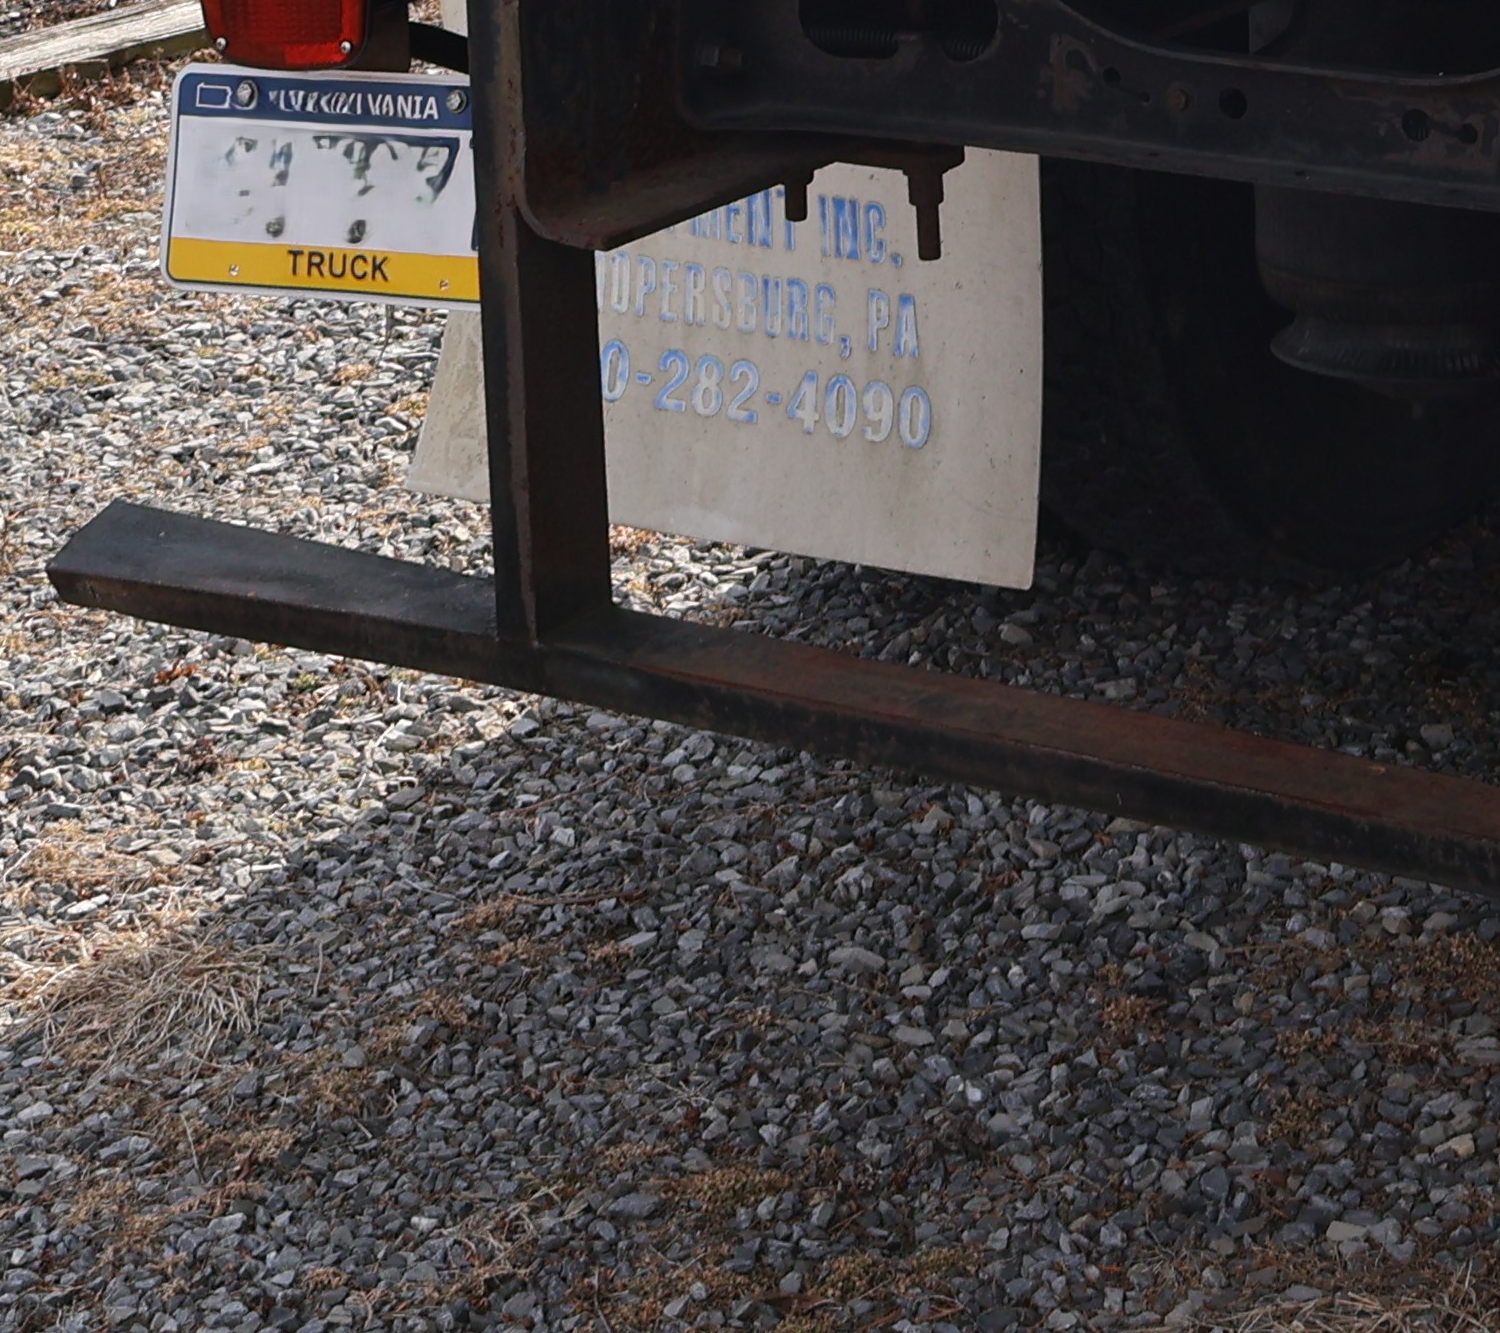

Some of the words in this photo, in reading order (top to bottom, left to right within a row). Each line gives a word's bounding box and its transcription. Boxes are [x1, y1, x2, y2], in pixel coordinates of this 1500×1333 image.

[287, 248, 390, 283] TRUCK
[817, 193, 903, 268] INC.
[866, 287, 920, 359] PA
